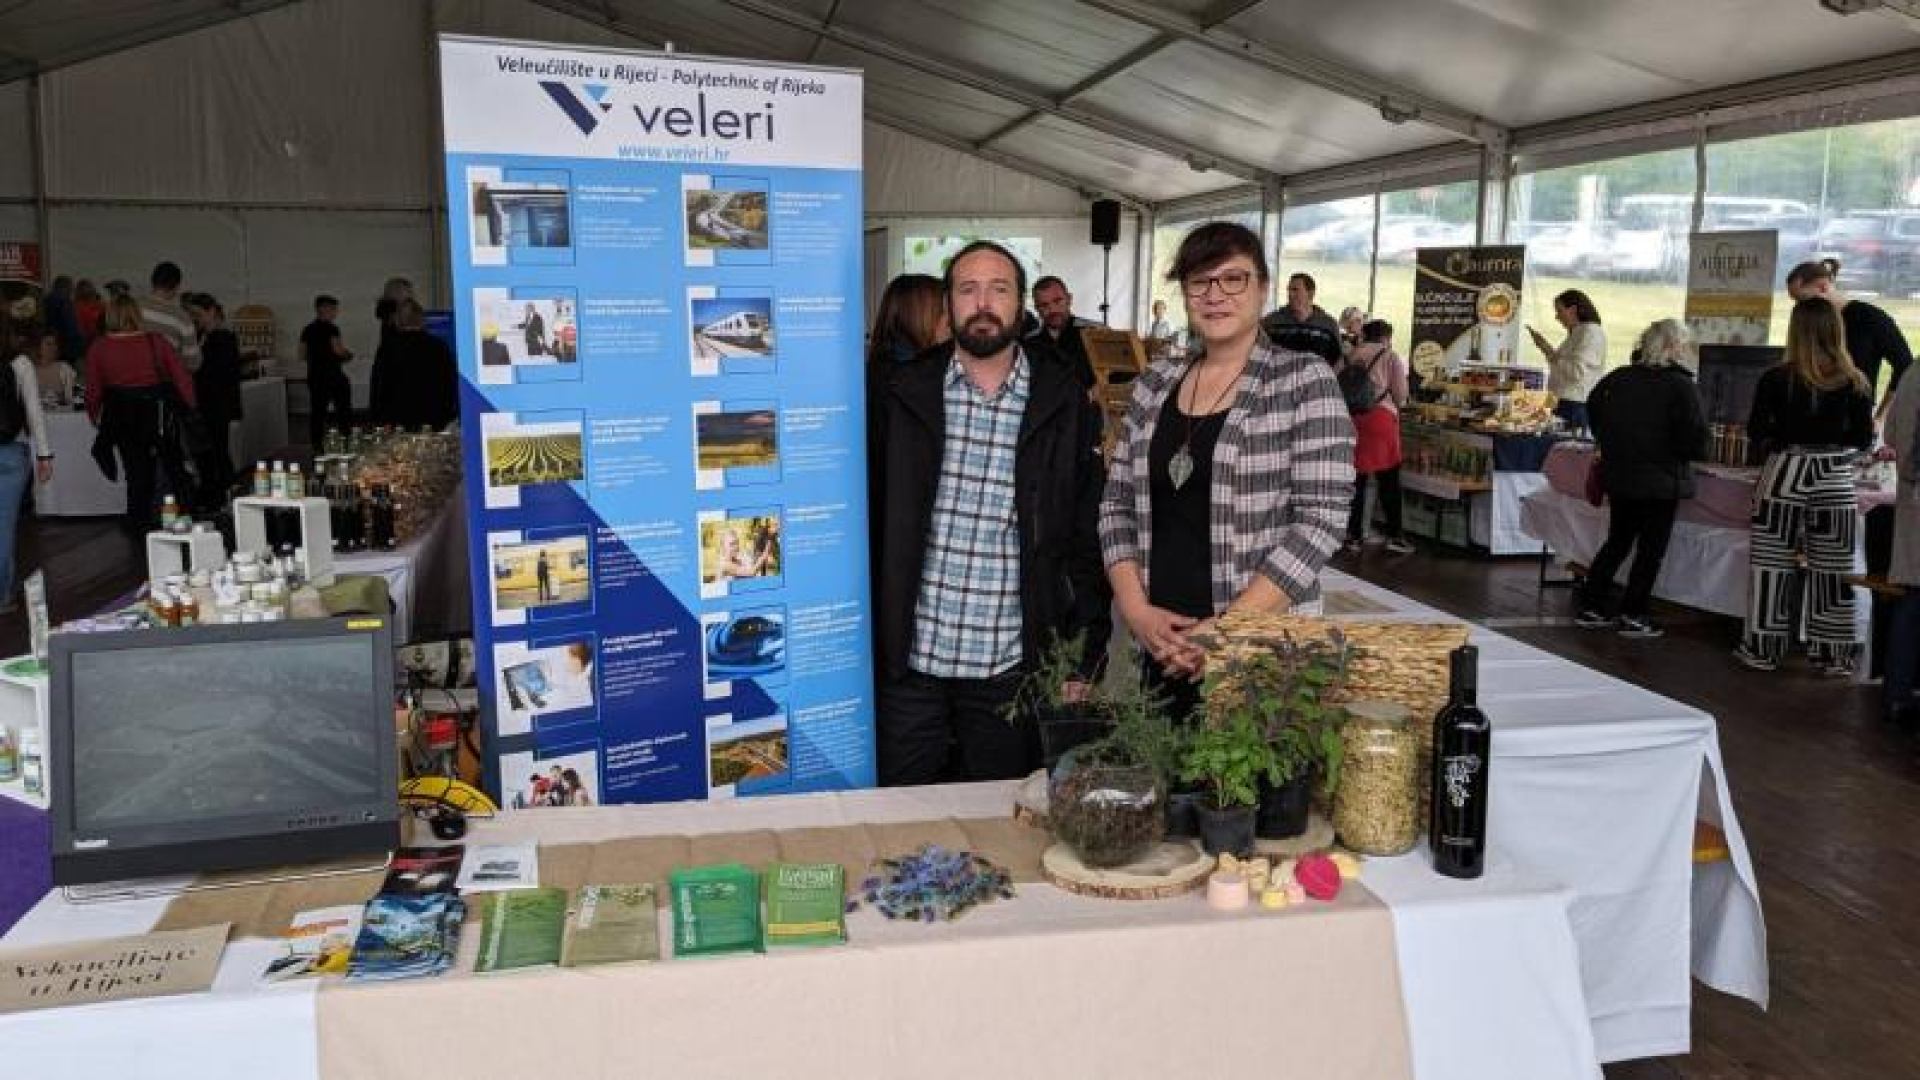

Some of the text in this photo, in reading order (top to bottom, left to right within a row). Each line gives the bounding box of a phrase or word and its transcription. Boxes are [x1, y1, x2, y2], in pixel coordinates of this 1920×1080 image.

[599, 66, 610, 79] u
[614, 64, 659, 84] Rijeci
[671, 69, 759, 89] Polytechnic
[763, 76, 779, 94] of
[782, 78, 827, 97] Rijeka
[633, 90, 775, 142] veleri
[618, 144, 731, 162] www.veleri.hr
